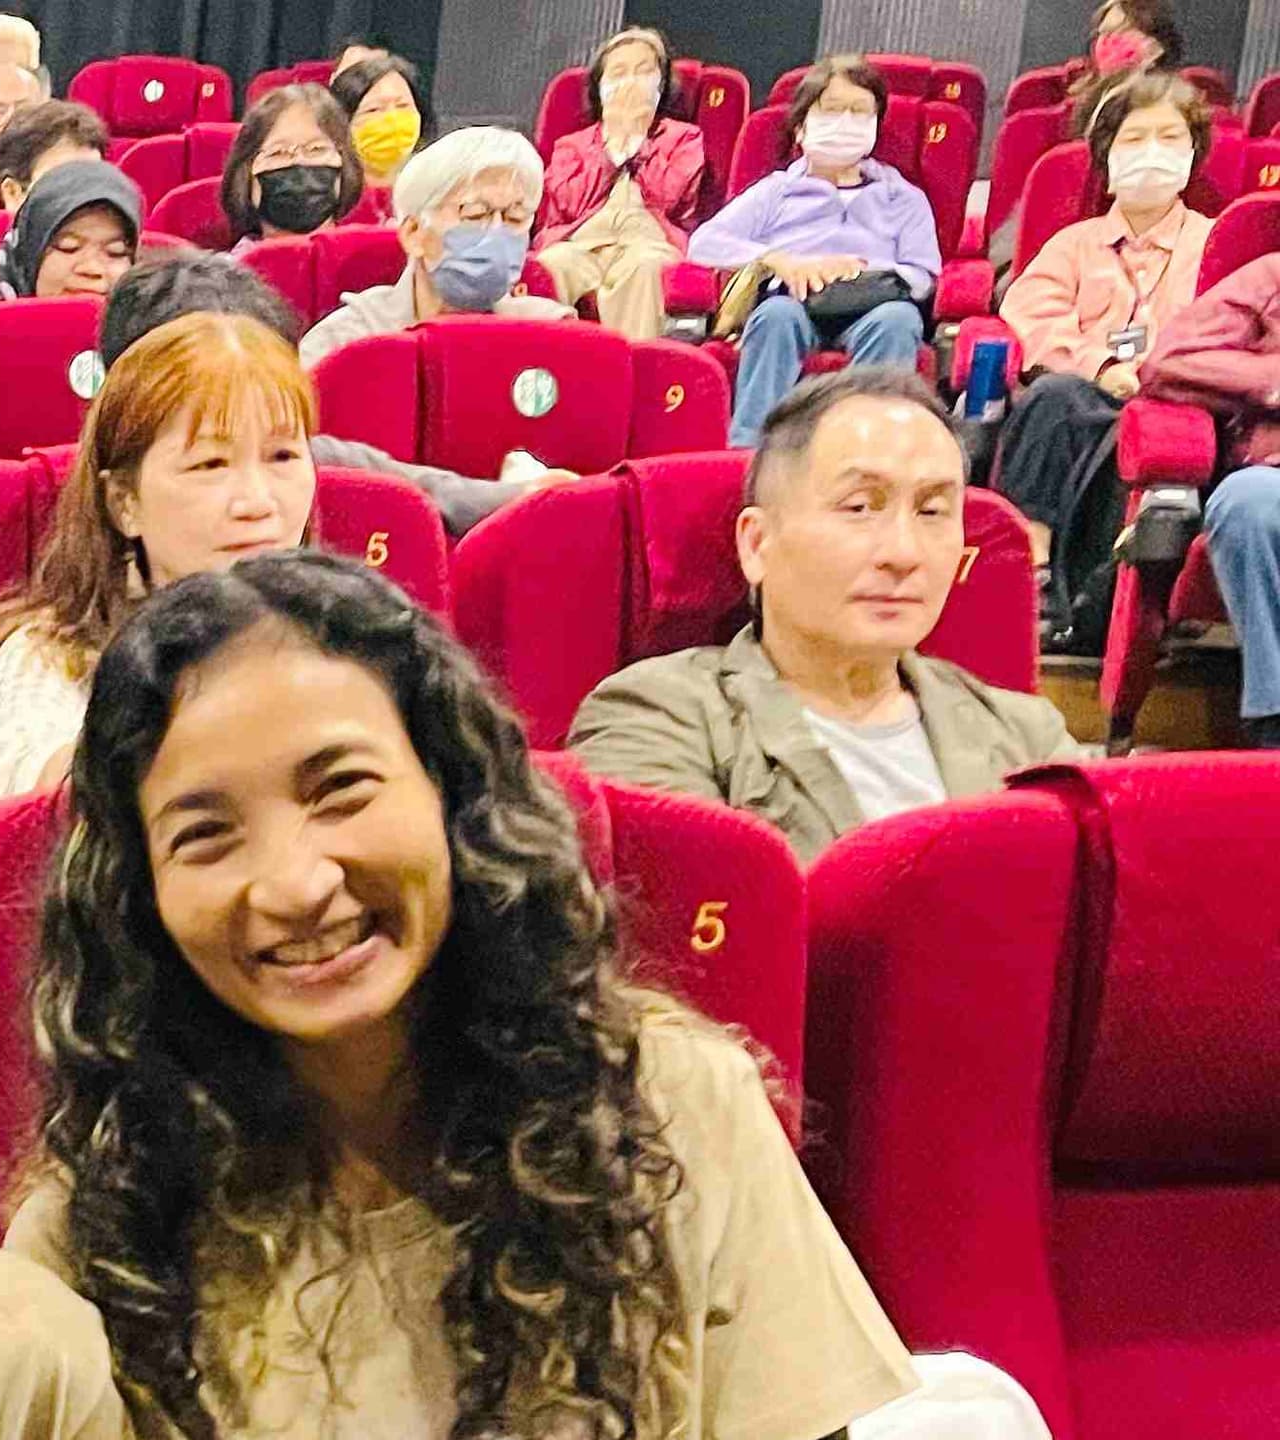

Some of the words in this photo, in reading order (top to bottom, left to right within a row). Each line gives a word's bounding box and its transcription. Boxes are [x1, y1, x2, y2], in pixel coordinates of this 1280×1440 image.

[664, 385, 685, 413] 9
[366, 532, 389, 566] 5
[690, 901, 728, 951] 5
